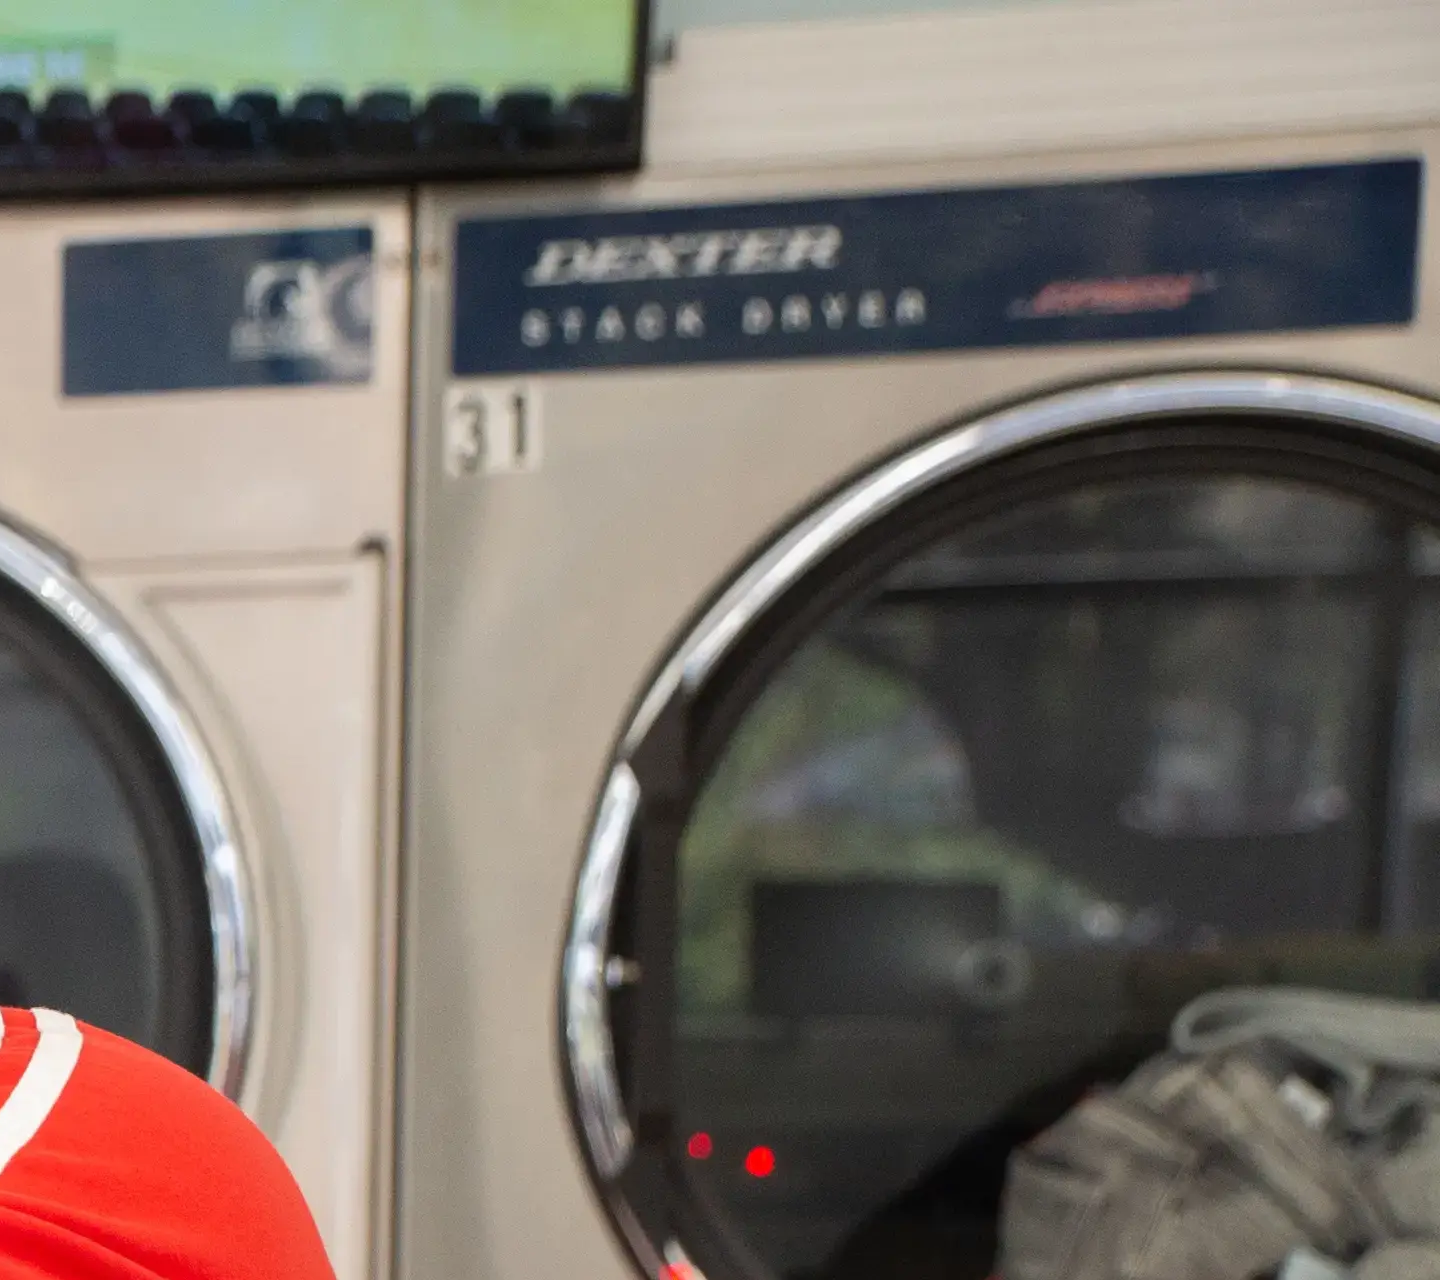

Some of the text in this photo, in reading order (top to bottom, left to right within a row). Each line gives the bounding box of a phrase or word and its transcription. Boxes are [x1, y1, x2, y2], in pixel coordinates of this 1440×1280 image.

[525, 225, 843, 287] DEXTER
[520, 287, 927, 348] STACK DRYER
[450, 391, 528, 476] 31
